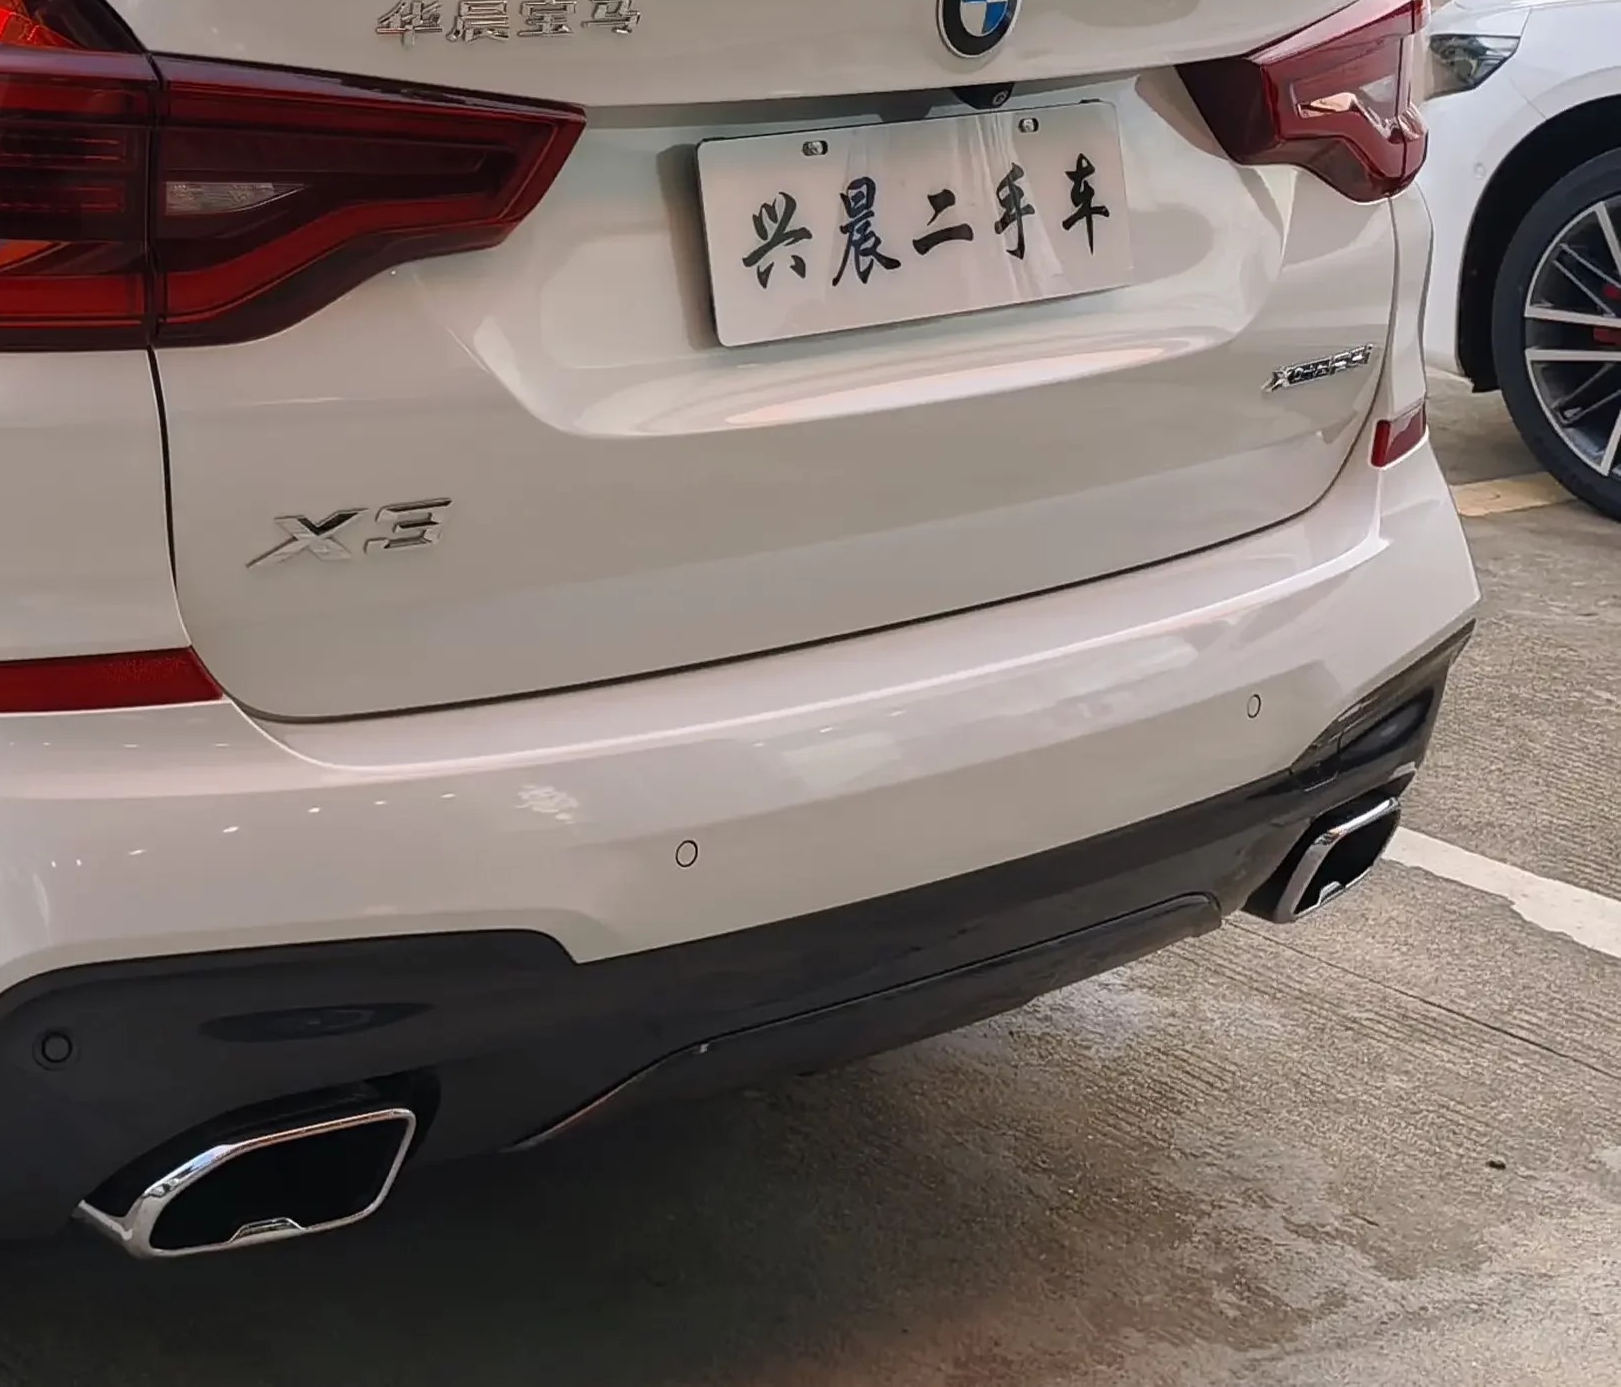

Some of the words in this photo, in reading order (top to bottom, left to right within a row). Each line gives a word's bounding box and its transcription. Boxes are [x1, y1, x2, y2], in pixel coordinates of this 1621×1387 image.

[742, 153, 1111, 288] 兴晨二手车
[245, 496, 453, 569] X3
